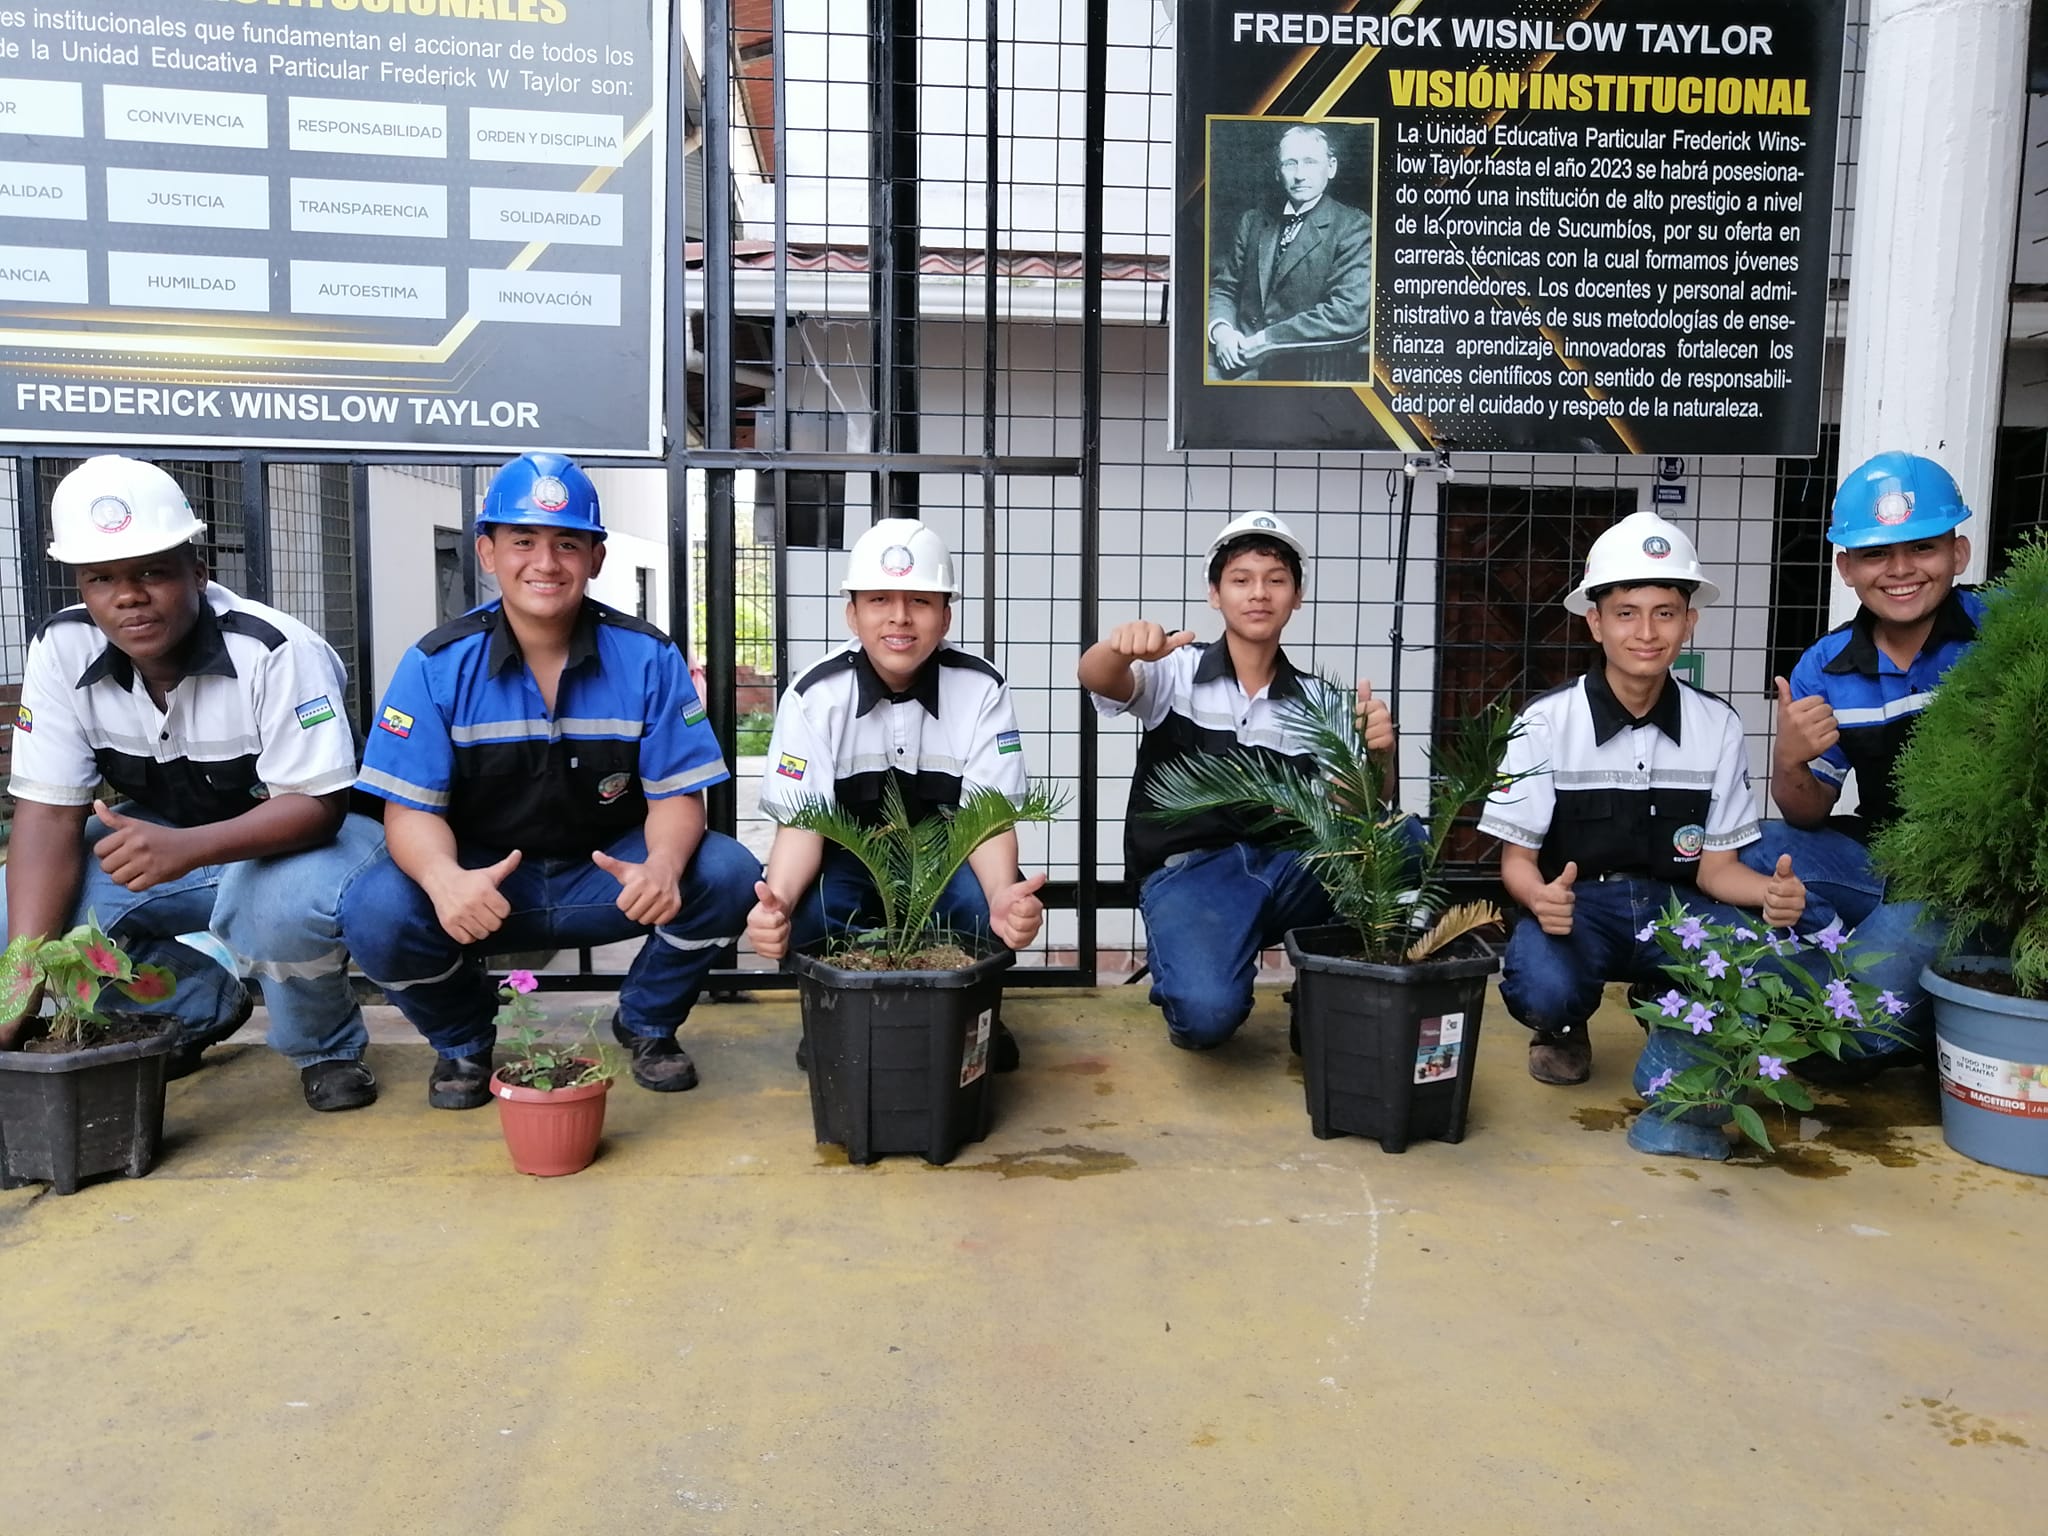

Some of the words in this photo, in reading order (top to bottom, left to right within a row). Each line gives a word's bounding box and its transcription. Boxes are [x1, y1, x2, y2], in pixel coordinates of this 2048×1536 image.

[0, 10, 26, 28] es
[33, 7, 187, 38] institucionales
[194, 20, 235, 43] que
[242, 21, 381, 51] fundamentan
[388, 32, 407, 52] el
[414, 35, 502, 58] accionar
[509, 40, 535, 60] de
[542, 42, 598, 64] todos
[605, 45, 634, 66] los
[1233, 12, 1442, 48] FREDERICK
[1452, 18, 1626, 53] WISNLOW
[1636, 23, 1774, 56] TAYLOR
[31, 38, 50, 60] la
[62, 39, 139, 66] Unidad
[152, 46, 257, 75] Educativa
[269, 54, 369, 82] Particular
[380, 62, 477, 88] Frederick
[487, 68, 509, 89] W
[520, 70, 581, 96] Taylor
[591, 77, 634, 96] son:
[1388, 65, 1520, 110] VISIÓN
[1529, 73, 1811, 115] INSTITUCIONAL
[127, 108, 244, 128] CONVIVENCIA
[298, 119, 442, 139] RESPONSABILIDAD
[476, 129, 525, 144] ORDEN
[528, 132, 538, 145] Y
[540, 133, 617, 149] DISCIPLINA
[1397, 122, 1419, 143] La
[1426, 123, 1487, 145] Unidad
[1494, 124, 1578, 147] Educativa
[1586, 127, 1666, 149] Particular
[1672, 129, 1751, 151] Frederick
[1758, 131, 1807, 151] Wins-
[1396, 153, 1426, 174] low
[1429, 153, 1479, 179] Taylor
[1485, 155, 1531, 177] hasta
[1535, 157, 1550, 177] el
[1554, 158, 1586, 178] año
[1590, 158, 1632, 179] 2023
[1636, 163, 1656, 180] se
[1660, 159, 1708, 181] habrá
[1712, 161, 1804, 185] posesiona-
[147, 192, 225, 208] JUSTICIA
[299, 200, 429, 218] TRANSPARENCIA
[1395, 183, 1418, 205] do
[1423, 189, 1471, 205] como
[1477, 190, 1509, 206] una
[1515, 186, 1599, 208] institución
[1605, 188, 1627, 209] de
[1633, 189, 1664, 210] alto
[1670, 190, 1741, 216] prestigio
[1746, 195, 1758, 211] a
[1763, 191, 1803, 212] nivel
[500, 210, 602, 226] SOLIDARIDAD
[1395, 214, 1417, 234] de
[1424, 214, 1440, 235] la
[1446, 216, 1522, 240] provincia
[1529, 216, 1550, 237] de
[1557, 217, 1656, 242] Sucumbíos,
[1663, 223, 1692, 244] por
[1697, 224, 1718, 241] su
[1724, 220, 1772, 241] oferta
[1779, 225, 1800, 241] en
[1394, 248, 1464, 265] carreras
[1470, 245, 1540, 266] técnicas
[1546, 251, 1577, 268] con
[1584, 248, 1598, 268] la
[1604, 249, 1639, 269] cual
[1645, 249, 1728, 270] formamos
[1732, 250, 1799, 275] jóvenes
[147, 275, 236, 291] HUMILDAD
[318, 283, 418, 300] AUTOESTIMA
[1394, 275, 1531, 299] emprendedores.
[1538, 276, 1569, 297] Los
[1575, 277, 1651, 299] docentes
[1657, 283, 1667, 304] y
[1673, 280, 1745, 304] personal
[1750, 280, 1797, 301] admi-
[498, 290, 592, 307] INNOVACIÓN
[1393, 304, 1469, 325] nistrativo
[1474, 309, 1485, 325] a
[1490, 305, 1542, 327] través
[1546, 306, 1568, 327] de
[1572, 311, 1602, 328] sus
[1607, 308, 1718, 334] metodologías
[1723, 310, 1744, 330] de
[1749, 314, 1796, 331] ense-
[1393, 333, 1444, 354] ñanza
[1455, 336, 1553, 360] aprendizaje
[1564, 336, 1666, 358] innovadoras
[1677, 337, 1758, 359] fortalecen
[1769, 339, 1794, 360] los
[1391, 367, 1463, 384] avances
[1468, 364, 1552, 386] científicos
[1557, 370, 1588, 387] con
[1594, 367, 1654, 388] sentido
[1660, 367, 1682, 388] de
[1687, 368, 1792, 392] responsabili-
[16, 383, 222, 418] FREDERICK
[230, 391, 399, 424] WINSLOW
[408, 397, 540, 428] TAYLOR
[1391, 393, 1423, 413] dad
[1428, 398, 1456, 418] por
[1459, 394, 1474, 414] el
[1478, 394, 1544, 415] cuidado
[1548, 400, 1559, 420] y
[1562, 397, 1625, 420] respeto
[1629, 396, 1650, 417] de
[1654, 396, 1668, 417] la
[1673, 397, 1763, 418] naturaleza.
[1965, 1064, 1995, 1078] PLANTAS
[1982, 1063, 1999, 1072] TIPO
[1970, 1090, 2026, 1111] MACETEROS
